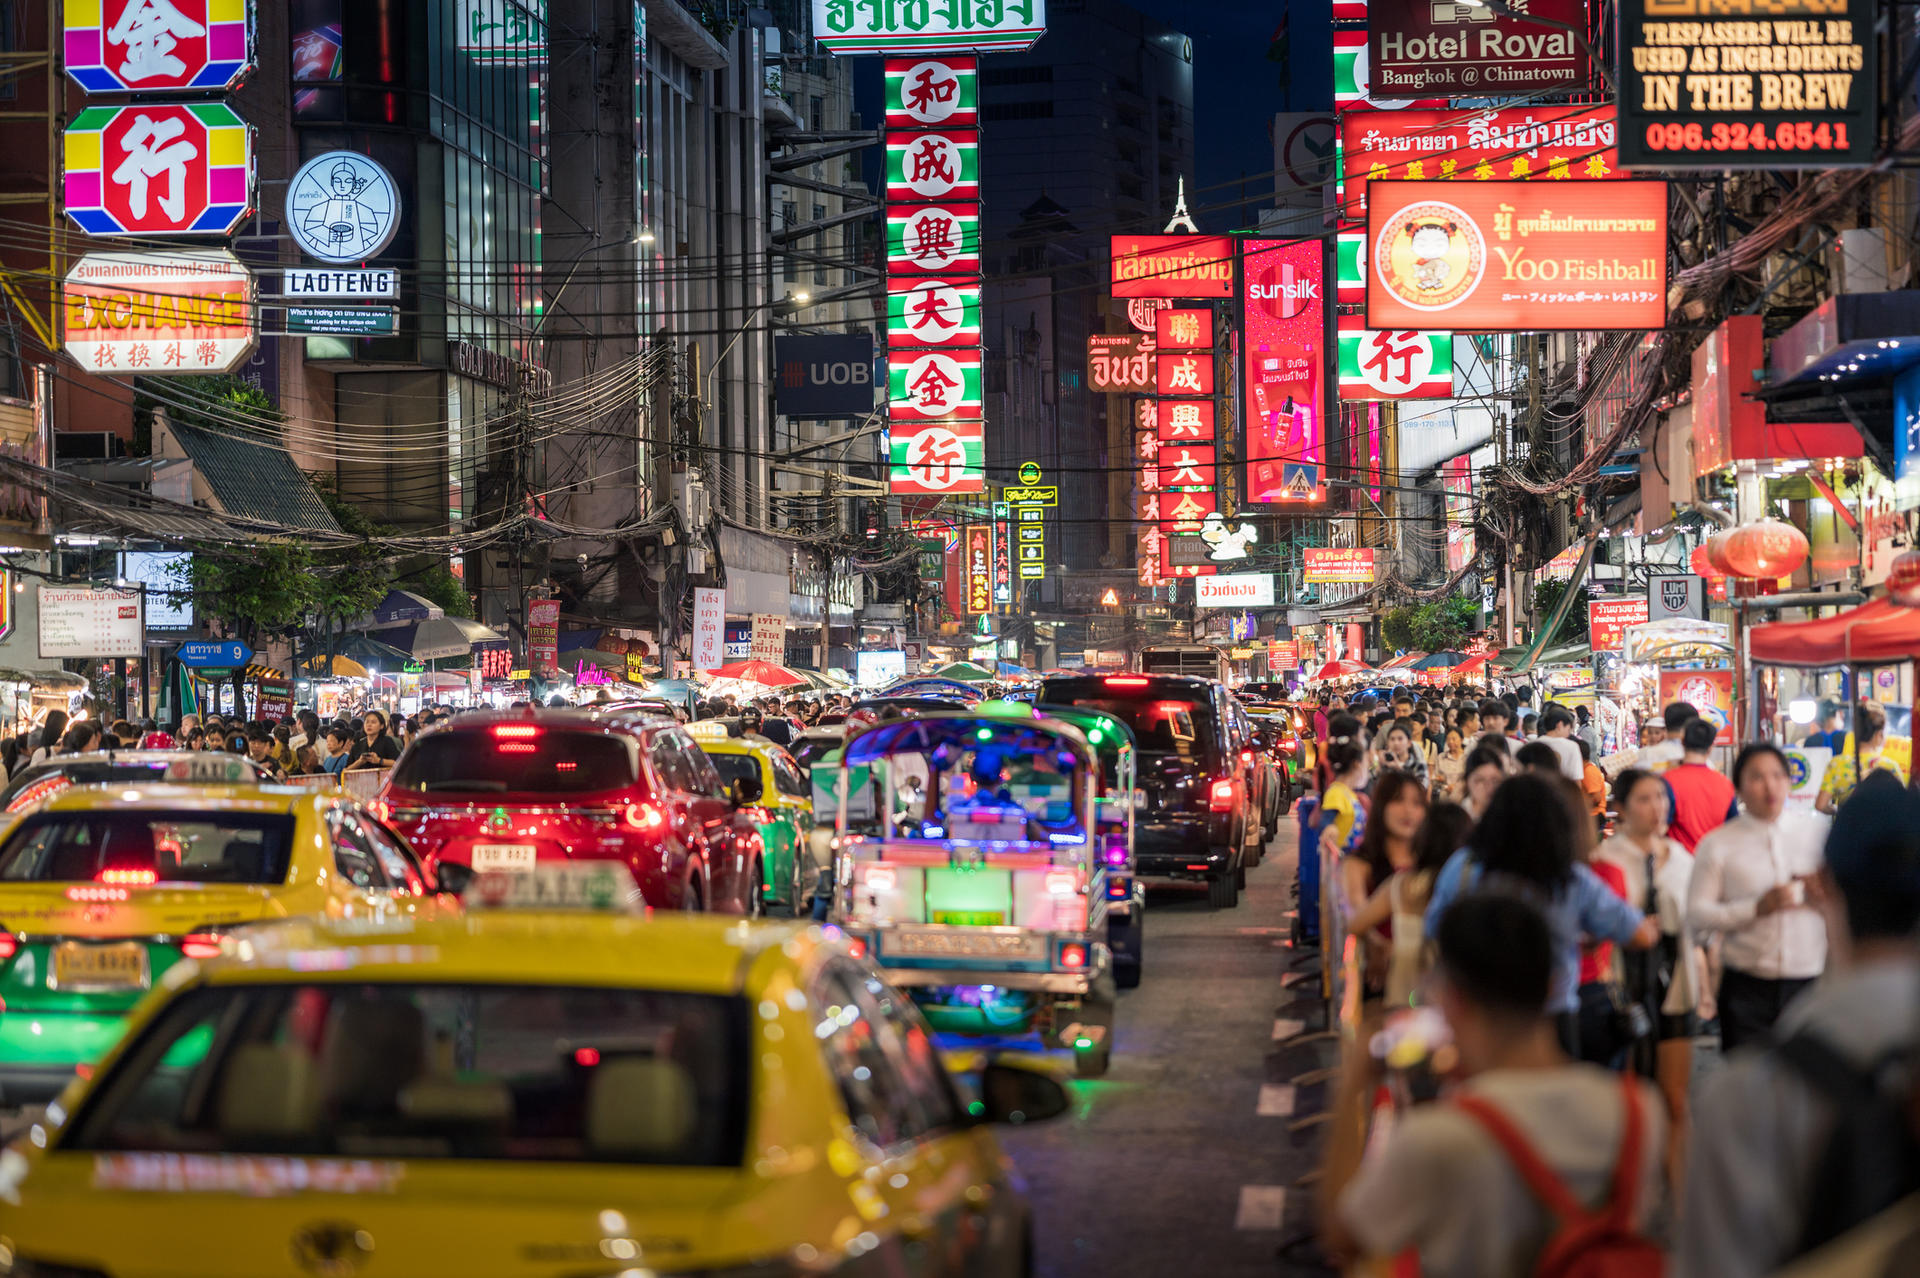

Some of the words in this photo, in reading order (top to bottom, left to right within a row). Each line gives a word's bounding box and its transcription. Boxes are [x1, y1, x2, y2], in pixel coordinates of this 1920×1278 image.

[1381, 30, 1467, 60] Hotel
[1480, 29, 1575, 59] Royal
[1642, 22, 1773, 46] TRESPASSERS
[1773, 21, 1824, 45] WILL
[1825, 20, 1853, 44] BE
[1632, 47, 1688, 73] USED
[1689, 47, 1719, 72] AS
[1720, 44, 1864, 72] INGREDIENTS
[1381, 68, 1456, 89] Bangkok
[1460, 66, 1480, 87] @
[1484, 67, 1576, 82] Chinatown
[1642, 74, 1680, 111] IN
[1686, 74, 1754, 111] THE
[1759, 73, 1853, 111] BREW
[1360, 129, 1458, 152] ร้านขายยา
[1466, 111, 1615, 159] ลิ้มซุ่นเฮง
[1646, 121, 1850, 151] 096.324.6541
[905, 68, 961, 484] 和成興大金行
[1115, 244, 1233, 281] เลี่ยงเซ่งเฮ
[1563, 258, 1657, 281] Fishball
[291, 273, 388, 292] LAOTENG
[1249, 279, 1318, 300] sunsilk
[66, 291, 244, 331] EXCHANGE
[93, 341, 222, 369] 找換外幣
[459, 341, 485, 377] GOLD
[1363, 330, 1424, 385] 行
[811, 361, 869, 386] UOB
[1168, 312, 1206, 577] 聯成興大金
[1663, 582, 1687, 595] LUMI
[1663, 596, 1687, 609] NOX
[186, 645, 222, 654] เยาวราช
[233, 646, 242, 660] 9
[727, 645, 740, 656] 24
